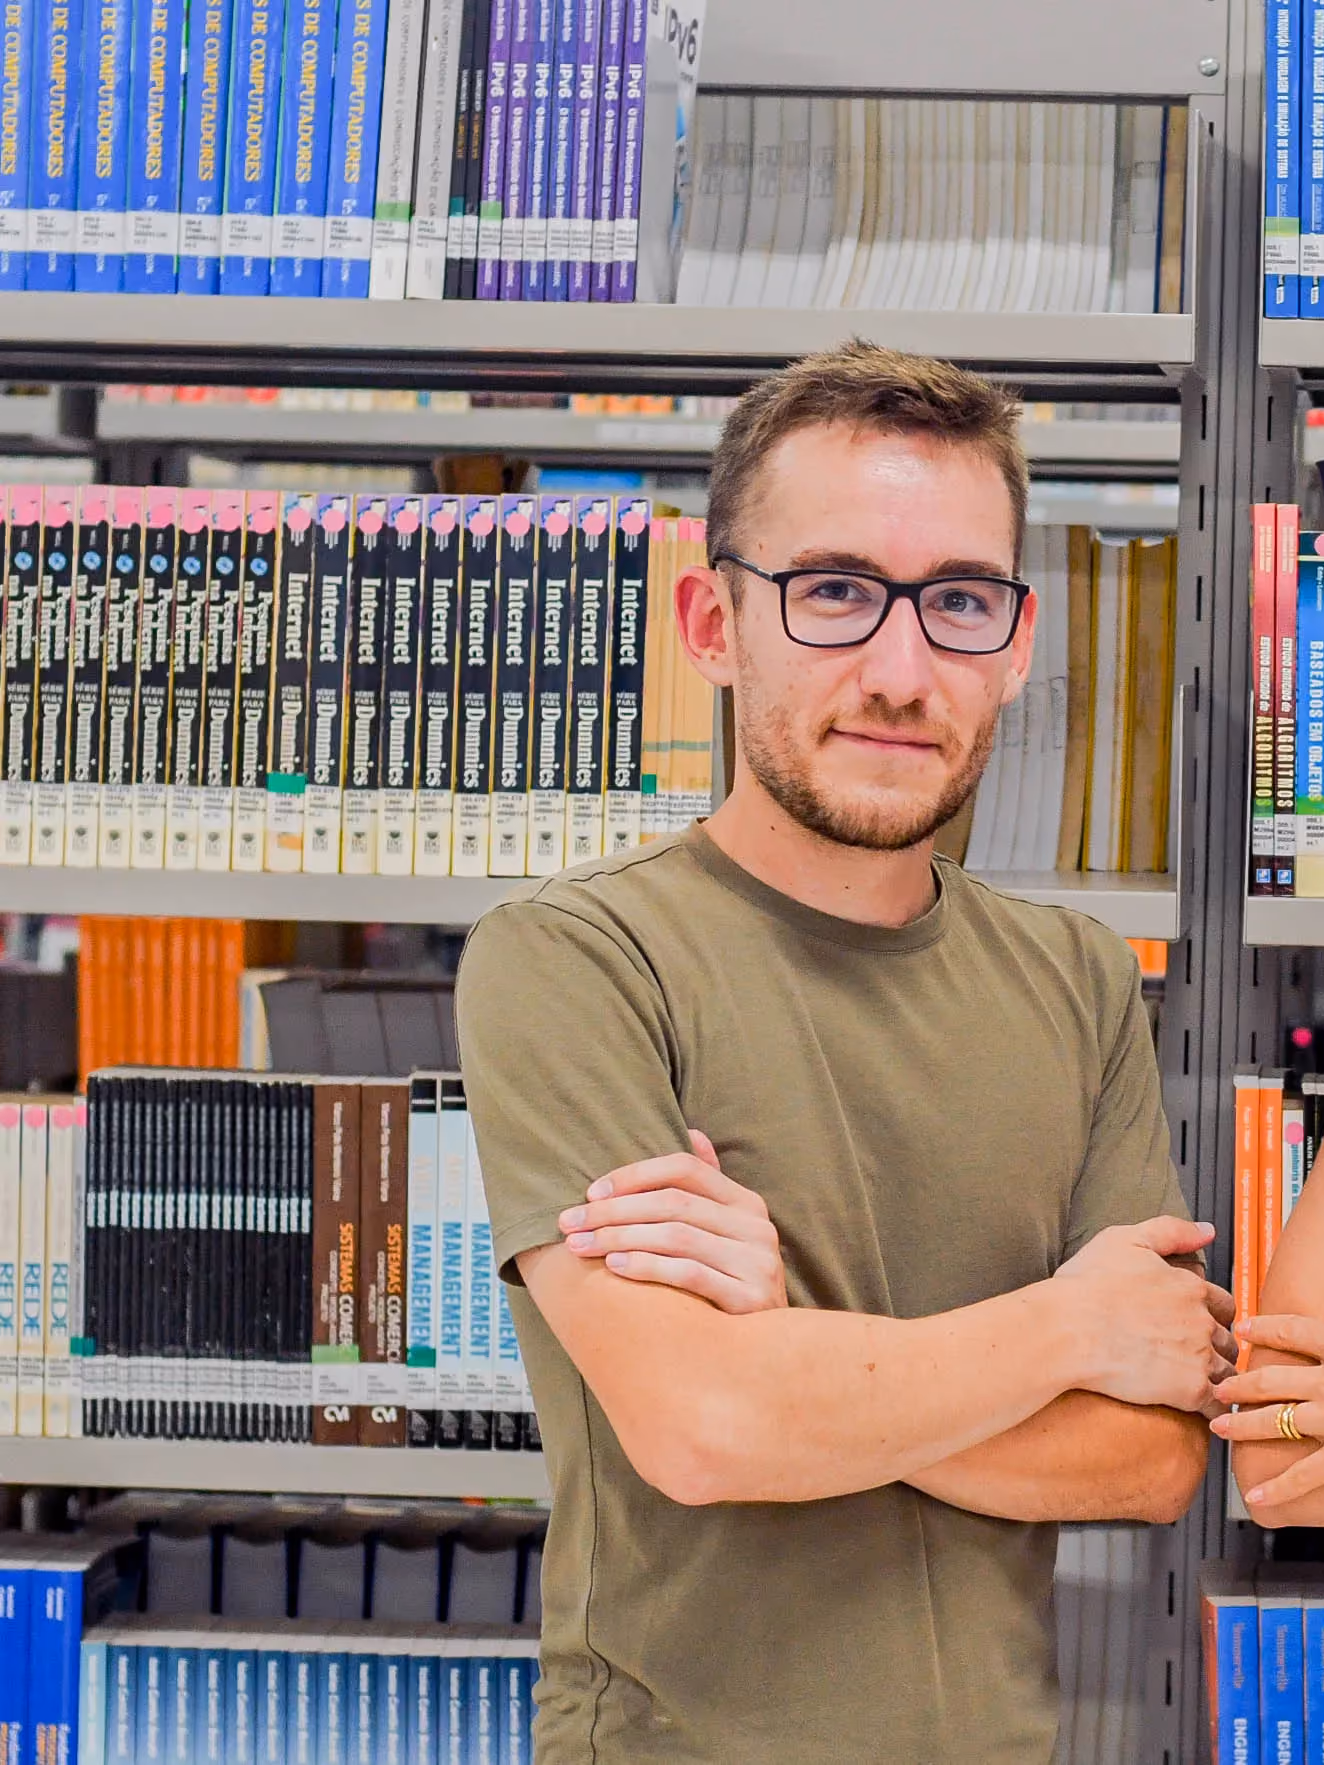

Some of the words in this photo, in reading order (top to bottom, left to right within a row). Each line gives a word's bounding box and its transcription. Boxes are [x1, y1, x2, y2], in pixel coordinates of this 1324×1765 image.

[5, 5, 21, 28] DE
[152, 9, 168, 32] DE
[252, 12, 268, 35] DE
[303, 12, 319, 36] DE
[354, 14, 370, 37] DE
[664, 6, 698, 64] IPv6
[1, 32, 20, 174] COMPUTADORES
[145, 36, 166, 179] COMPUTADORES
[244, 39, 266, 182] COMPUTADORES
[295, 40, 317, 183] COMPUTADORES
[344, 41, 368, 183] COMPUTADORES
[490, 62, 505, 98] IPv6
[534, 63, 549, 98] IPv6
[627, 64, 642, 99] IPv6
[244, 581, 255, 602] na
[254, 591, 273, 665] Pesquisa
[285, 572, 308, 660] Internet
[319, 575, 343, 662] Internet
[505, 578, 529, 666] Internet
[618, 578, 642, 666] Internet
[241, 606, 257, 673] Internet
[1309, 640, 1324, 717] BASEADOS
[242, 709, 263, 786] Dummies
[279, 701, 302, 774] Dummie
[314, 703, 337, 784] Dummies
[502, 707, 523, 788] Dummies
[614, 707, 638, 788] Dummies
[1256, 716, 1272, 806] ALGORITMOS
[1278, 716, 1294, 807] ALGORITMOS
[1308, 722, 1323, 742] EM
[1308, 746, 1323, 801] OBJETOS
[339, 1222, 355, 1293] SISTEMAS
[387, 1223, 402, 1293] SISTEMAS
[411, 1224, 432, 1348] MANAGEMEN
[441, 1222, 462, 1358] MANAGEMENT
[470, 1222, 491, 1359] MANAGEMENT
[23, 1263, 40, 1337] REDE
[51, 1263, 69, 1337] REDE
[339, 1295, 354, 1346] COMER
